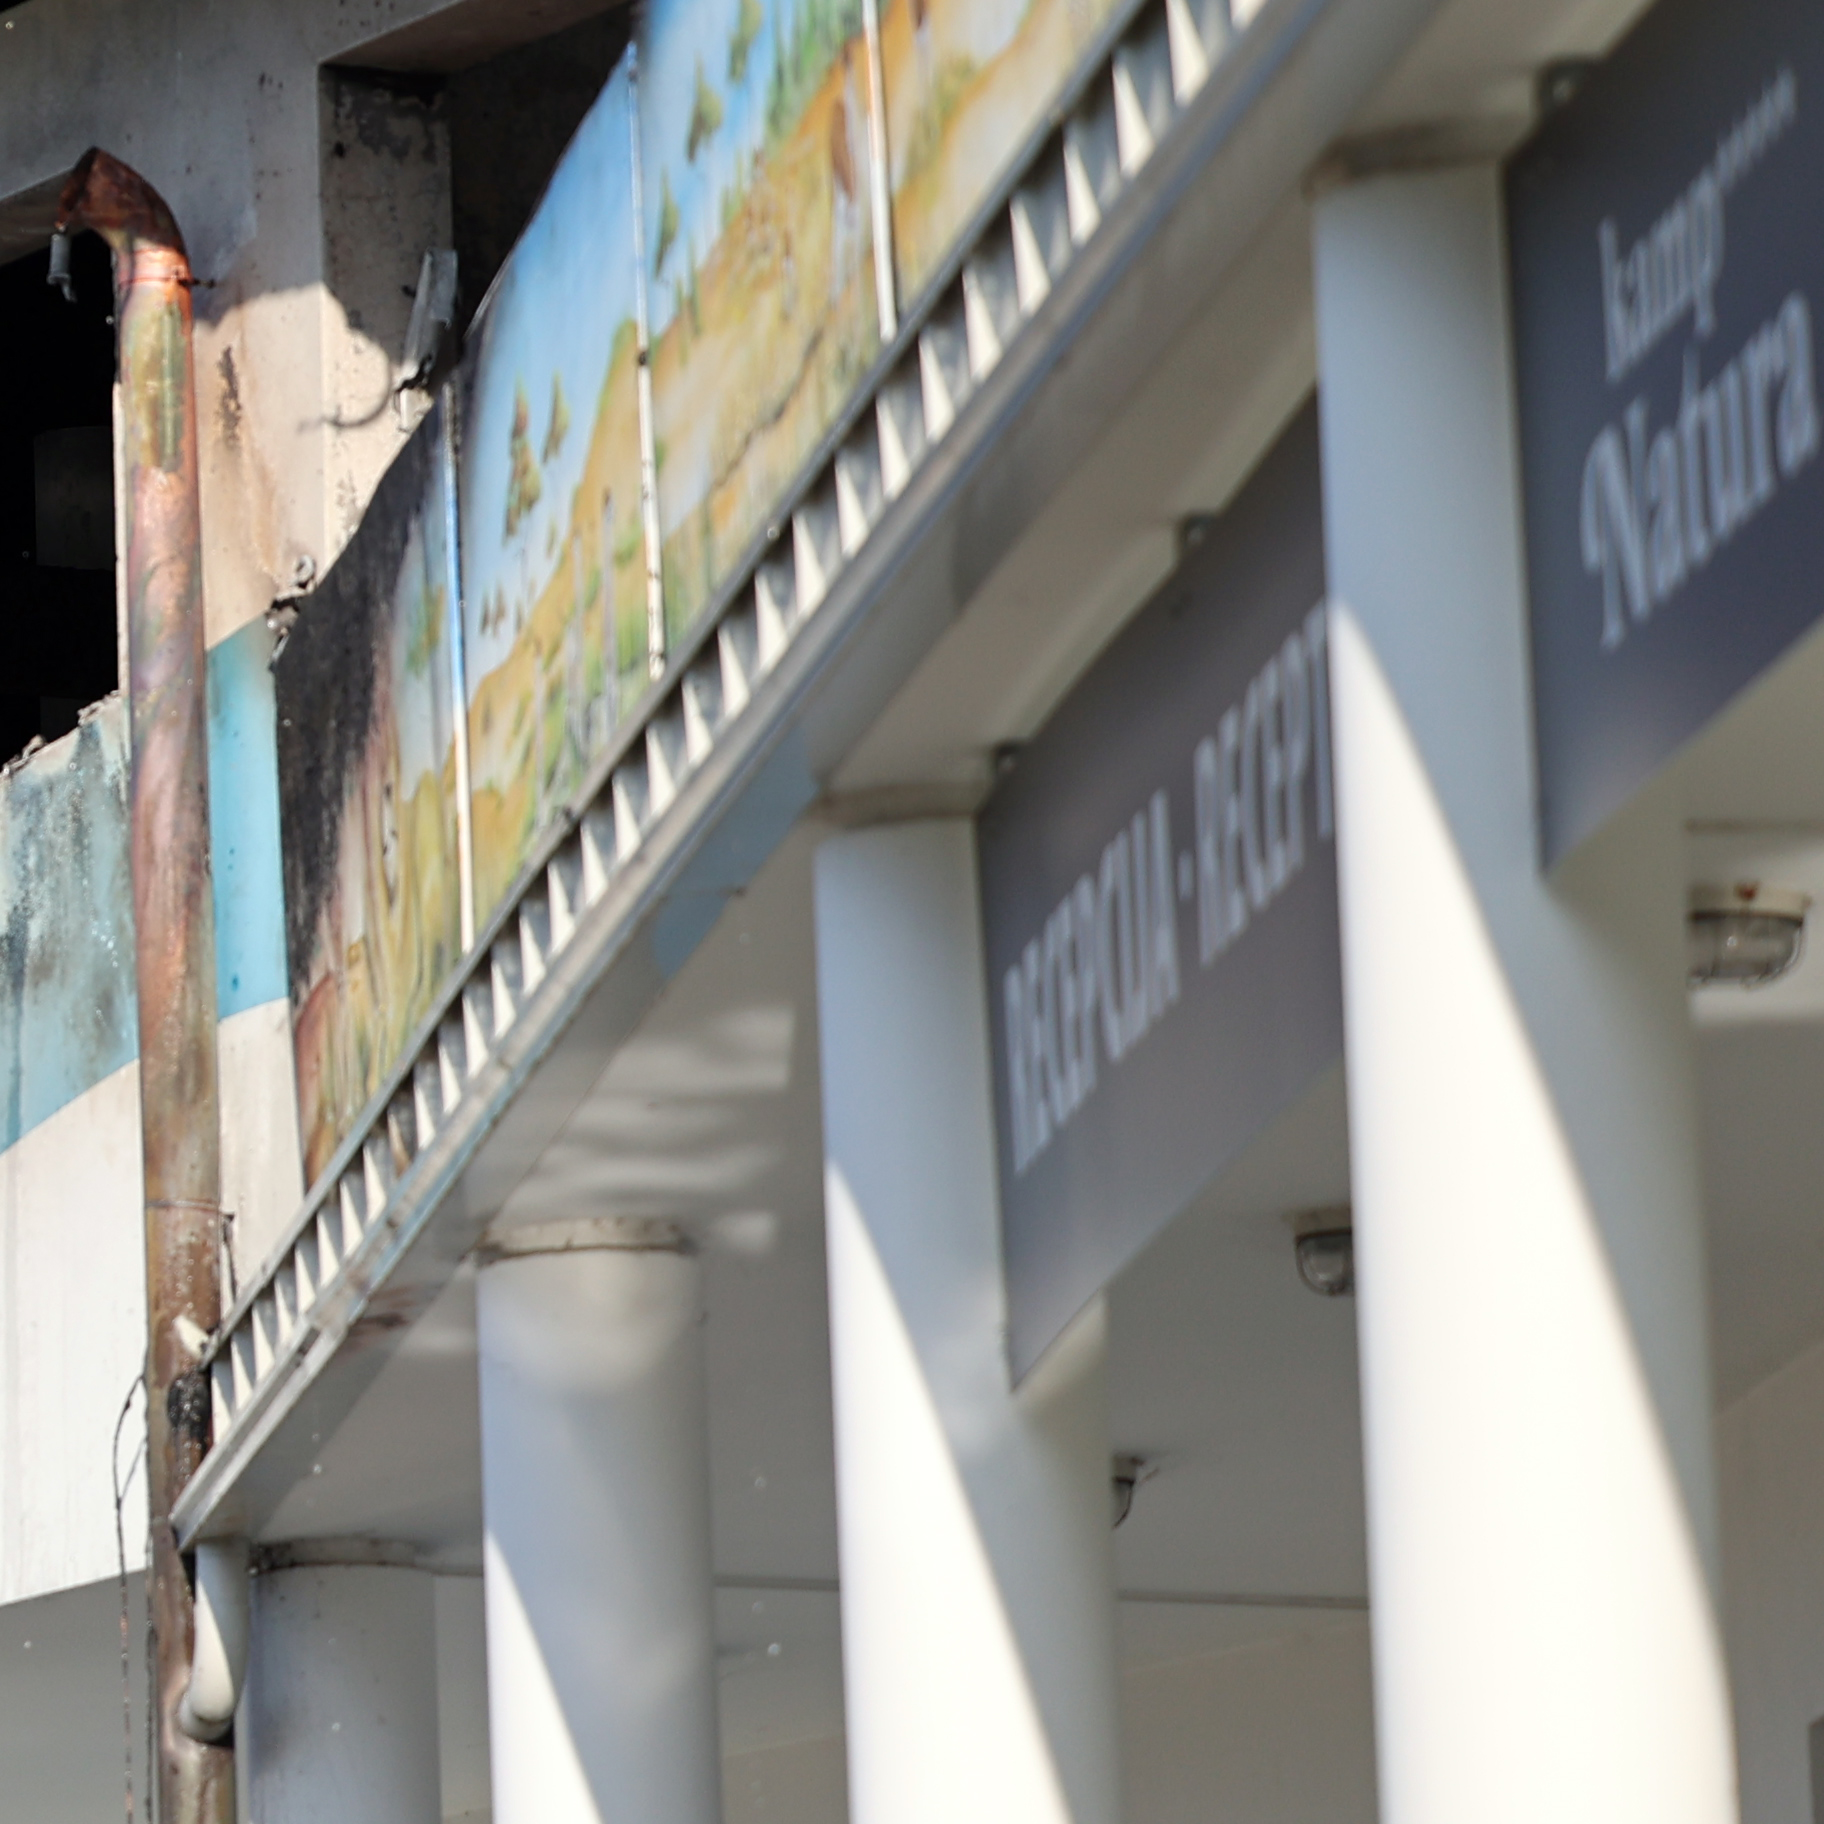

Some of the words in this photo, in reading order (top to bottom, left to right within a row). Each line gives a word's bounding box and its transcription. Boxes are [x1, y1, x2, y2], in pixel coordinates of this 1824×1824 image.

[1599, 167, 1723, 383] kamp
[1579, 289, 1821, 650] Natura
[1004, 788, 1181, 1174] RECEPCIJA
